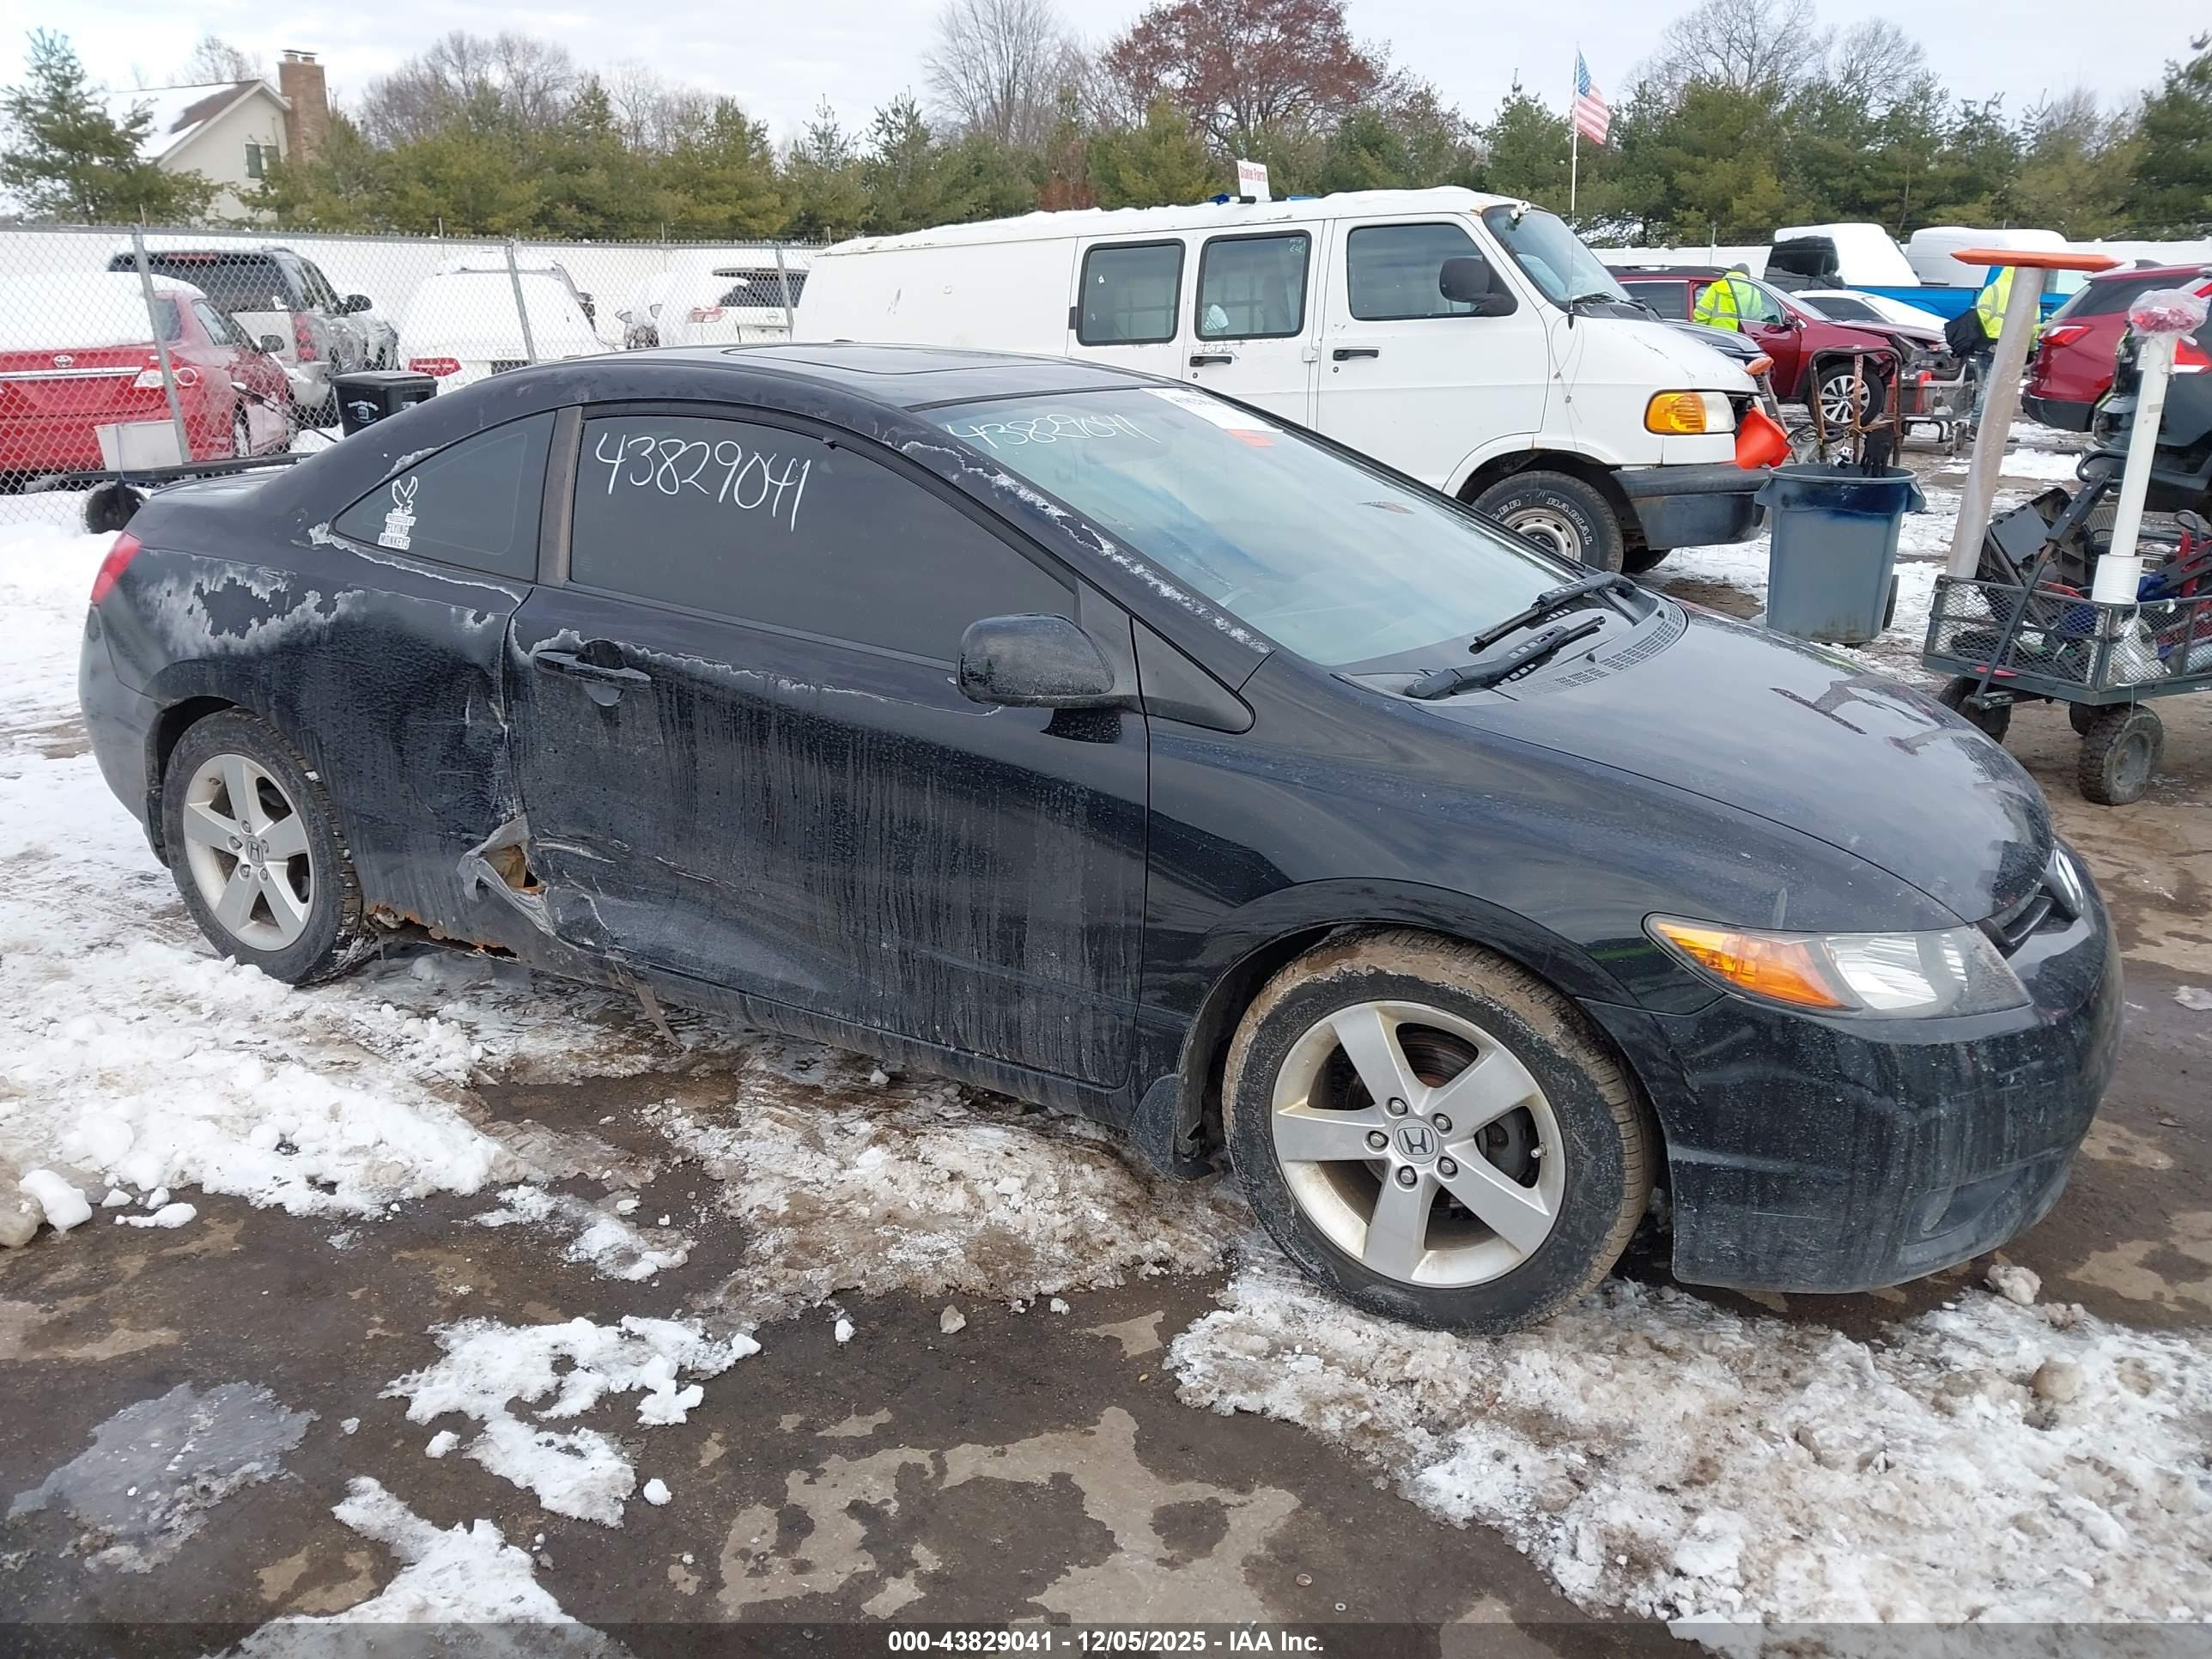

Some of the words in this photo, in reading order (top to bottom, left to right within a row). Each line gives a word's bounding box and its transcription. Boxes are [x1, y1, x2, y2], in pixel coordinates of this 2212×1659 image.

[945, 412, 1162, 449] 43829041
[595, 432, 811, 532] 43829041
[1546, 496, 1594, 546] RADIAL
